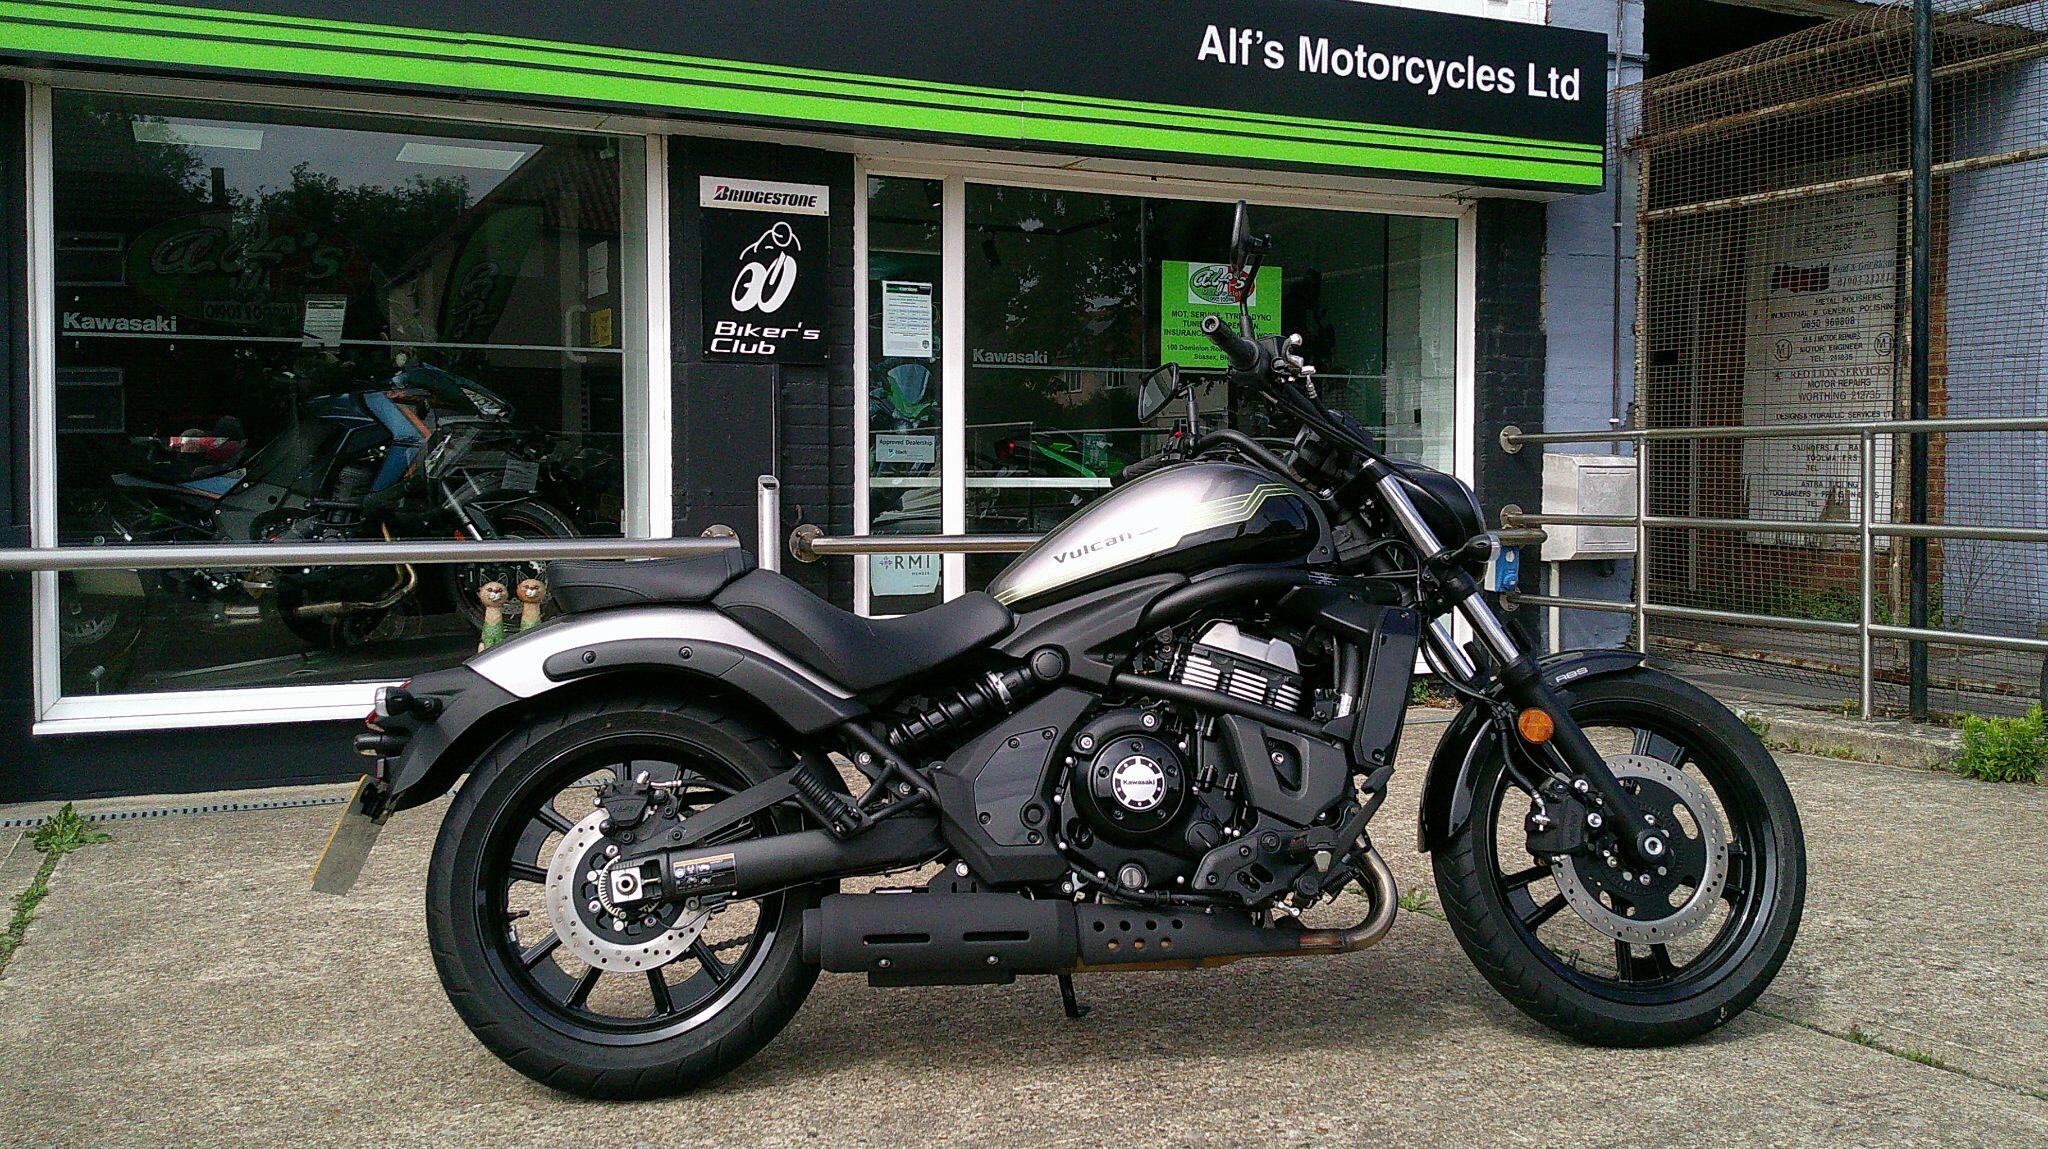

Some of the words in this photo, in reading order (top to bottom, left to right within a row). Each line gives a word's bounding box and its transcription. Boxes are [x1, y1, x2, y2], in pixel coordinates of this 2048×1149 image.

[1197, 24, 1285, 70] Alf's
[1298, 35, 1516, 95] Motorcycles
[1527, 62, 1580, 101] Ltd
[714, 185, 818, 208] BRIDGESTONE
[63, 311, 178, 332] Kawasaki
[1251, 313, 1272, 322] DYNO
[714, 320, 821, 340] Biker's
[710, 338, 776, 355] Club
[1179, 344, 1209, 352] Dominion
[972, 348, 1048, 364] Kawasaki
[1840, 365, 1890, 377] SERVICES
[1807, 380, 1836, 388] MOTOR
[905, 439, 934, 447] Dealership
[1806, 454, 1858, 462] TOOLMAERS
[894, 554, 930, 570] RMI
[1555, 666, 1589, 683] ABS
